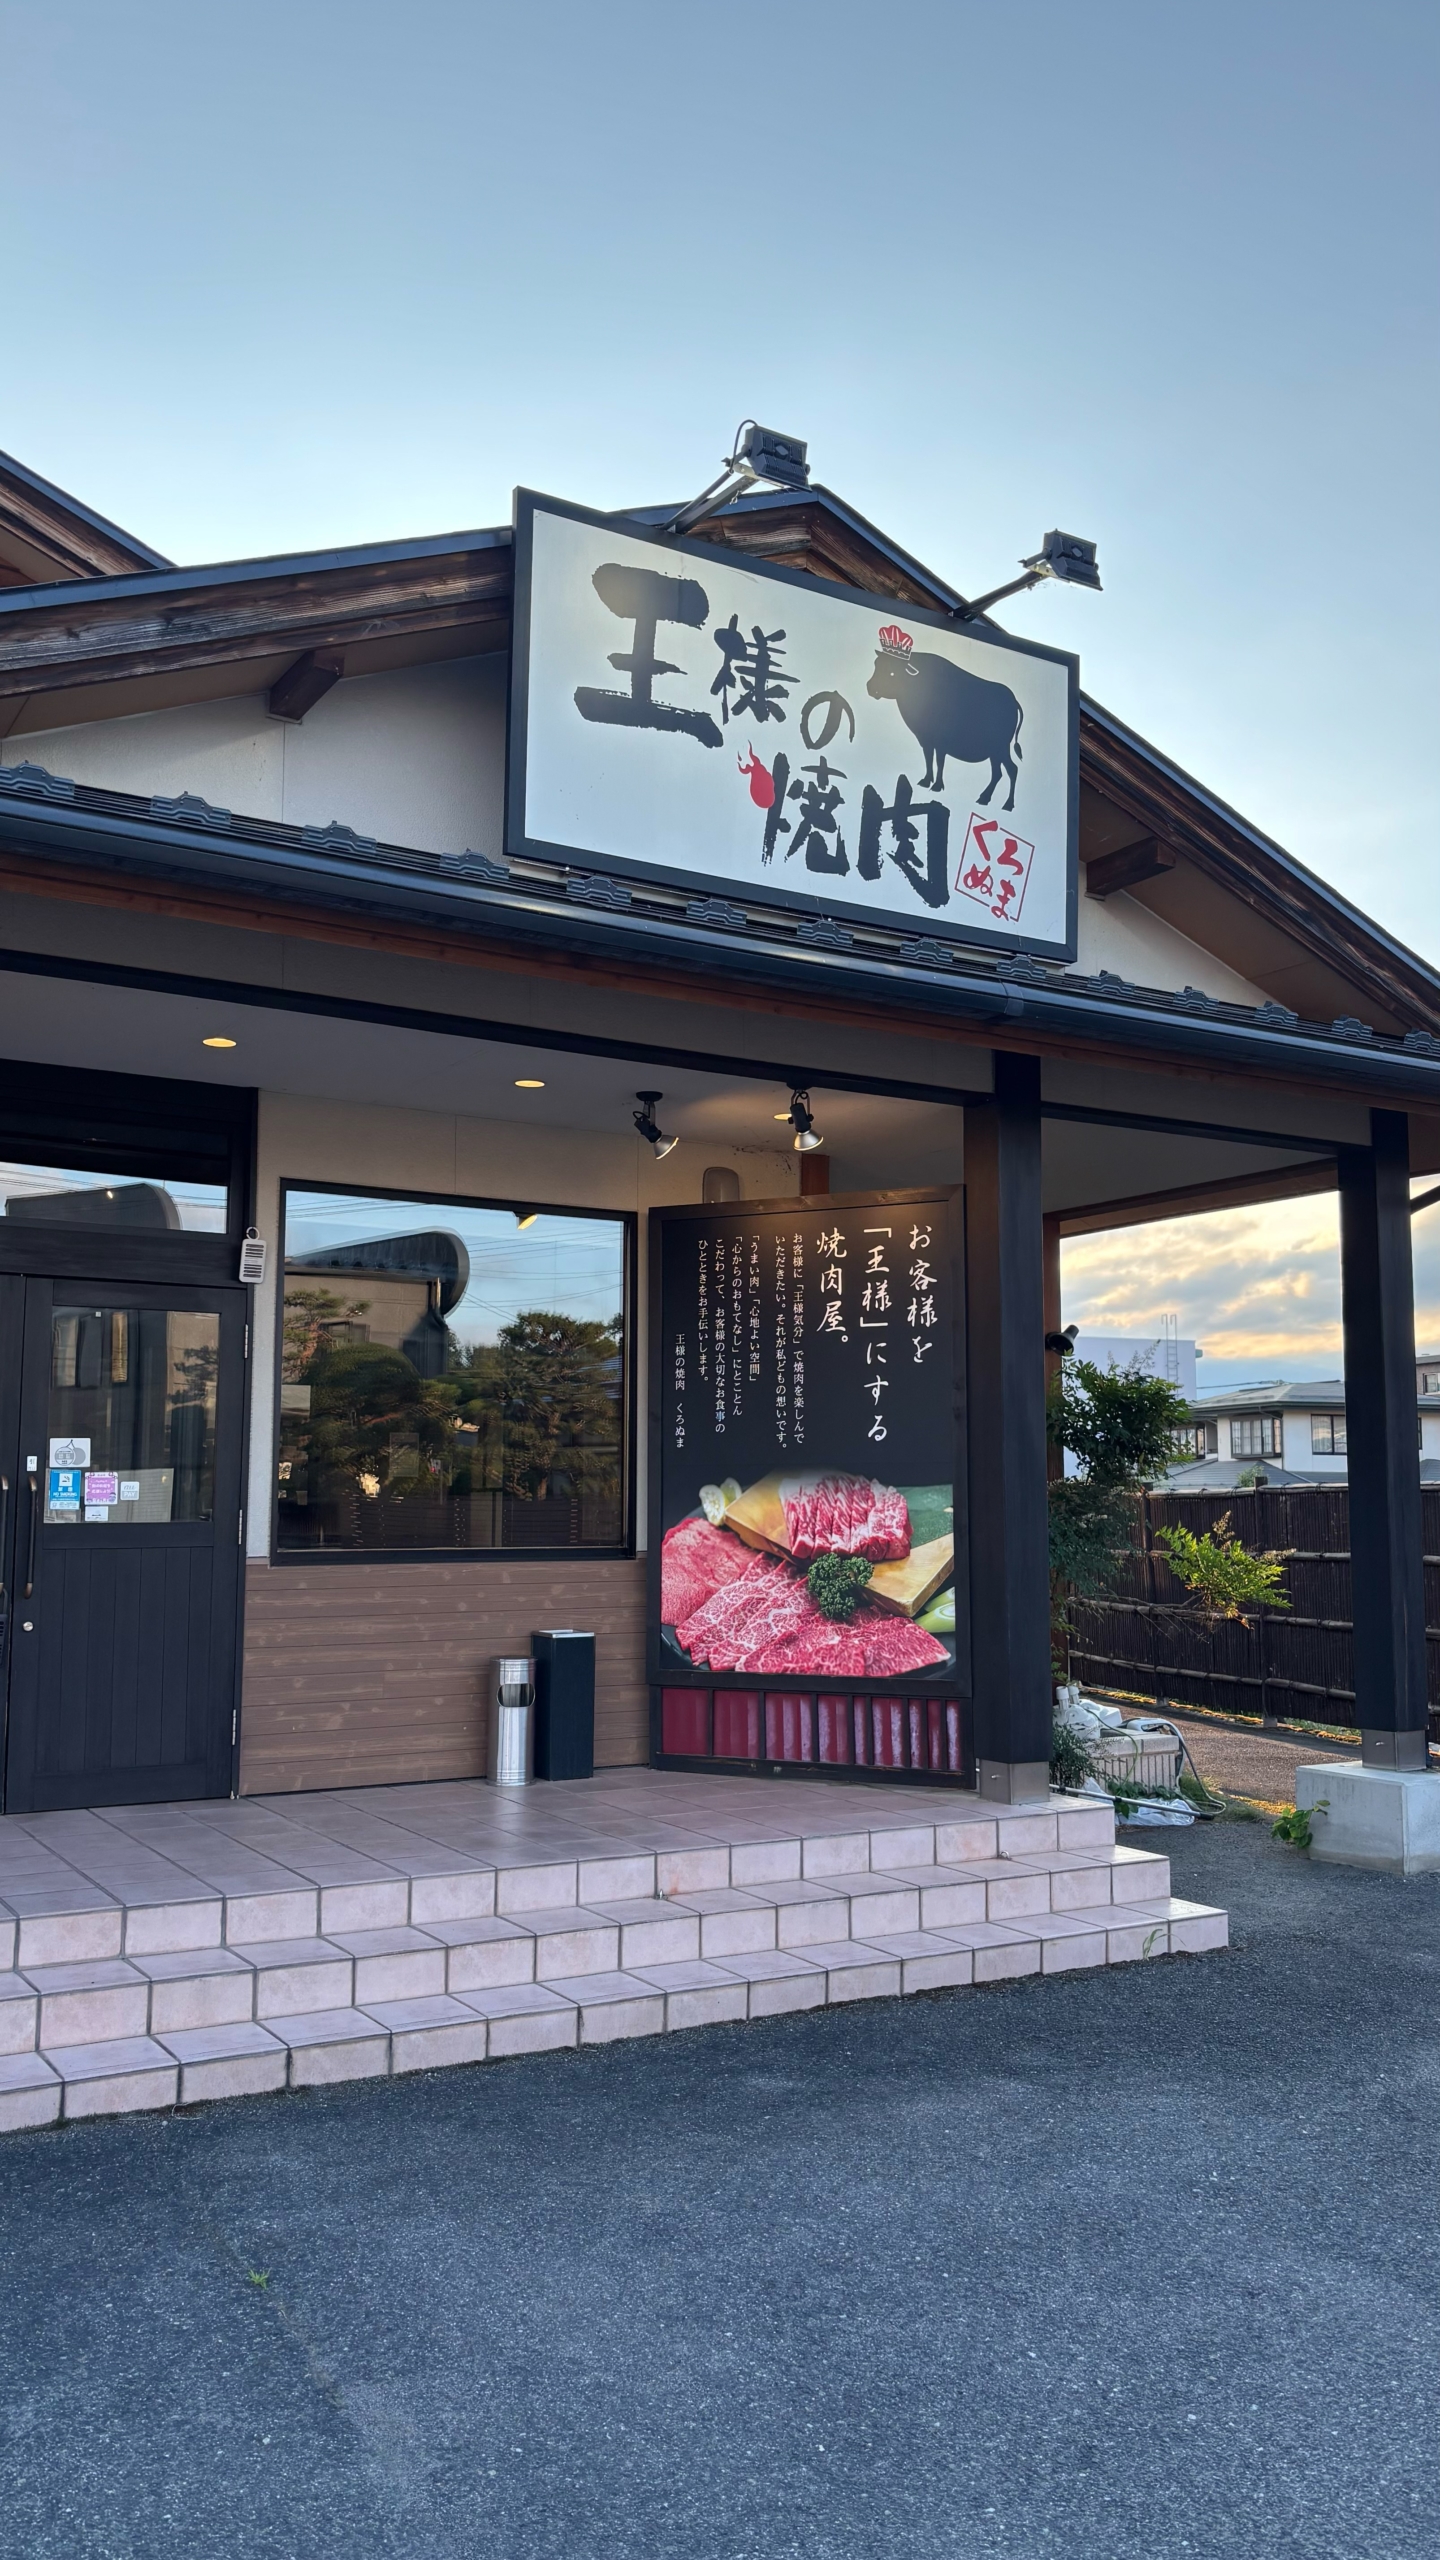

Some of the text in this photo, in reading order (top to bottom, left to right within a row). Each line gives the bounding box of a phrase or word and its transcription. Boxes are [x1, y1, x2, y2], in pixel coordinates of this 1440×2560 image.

[573, 562, 855, 750] 王様の
[737, 741, 951, 909] 焼肉
[697, 1239, 709, 1381] ひとときをお手伝いします。
[714, 1238, 726, 1433] こだわって、お客様の大切なお食事の
[731, 1236, 743, 1416] 「心からのおもてなし」にとことん
[748, 1235, 761, 1382] 「うまい肉」「心地よい空間」
[775, 1235, 787, 1449] いただきたい。それが私どもの想いです。
[792, 1232, 805, 1444] お客様に「王様気分」で焼肉を楽しんで
[816, 1226, 849, 1343] 焼肉屋。
[859, 1227, 893, 1442] 「王様」にする
[907, 1224, 938, 1364] お客様を
[674, 1333, 686, 1448] 王様の焼肉 くろぬま
